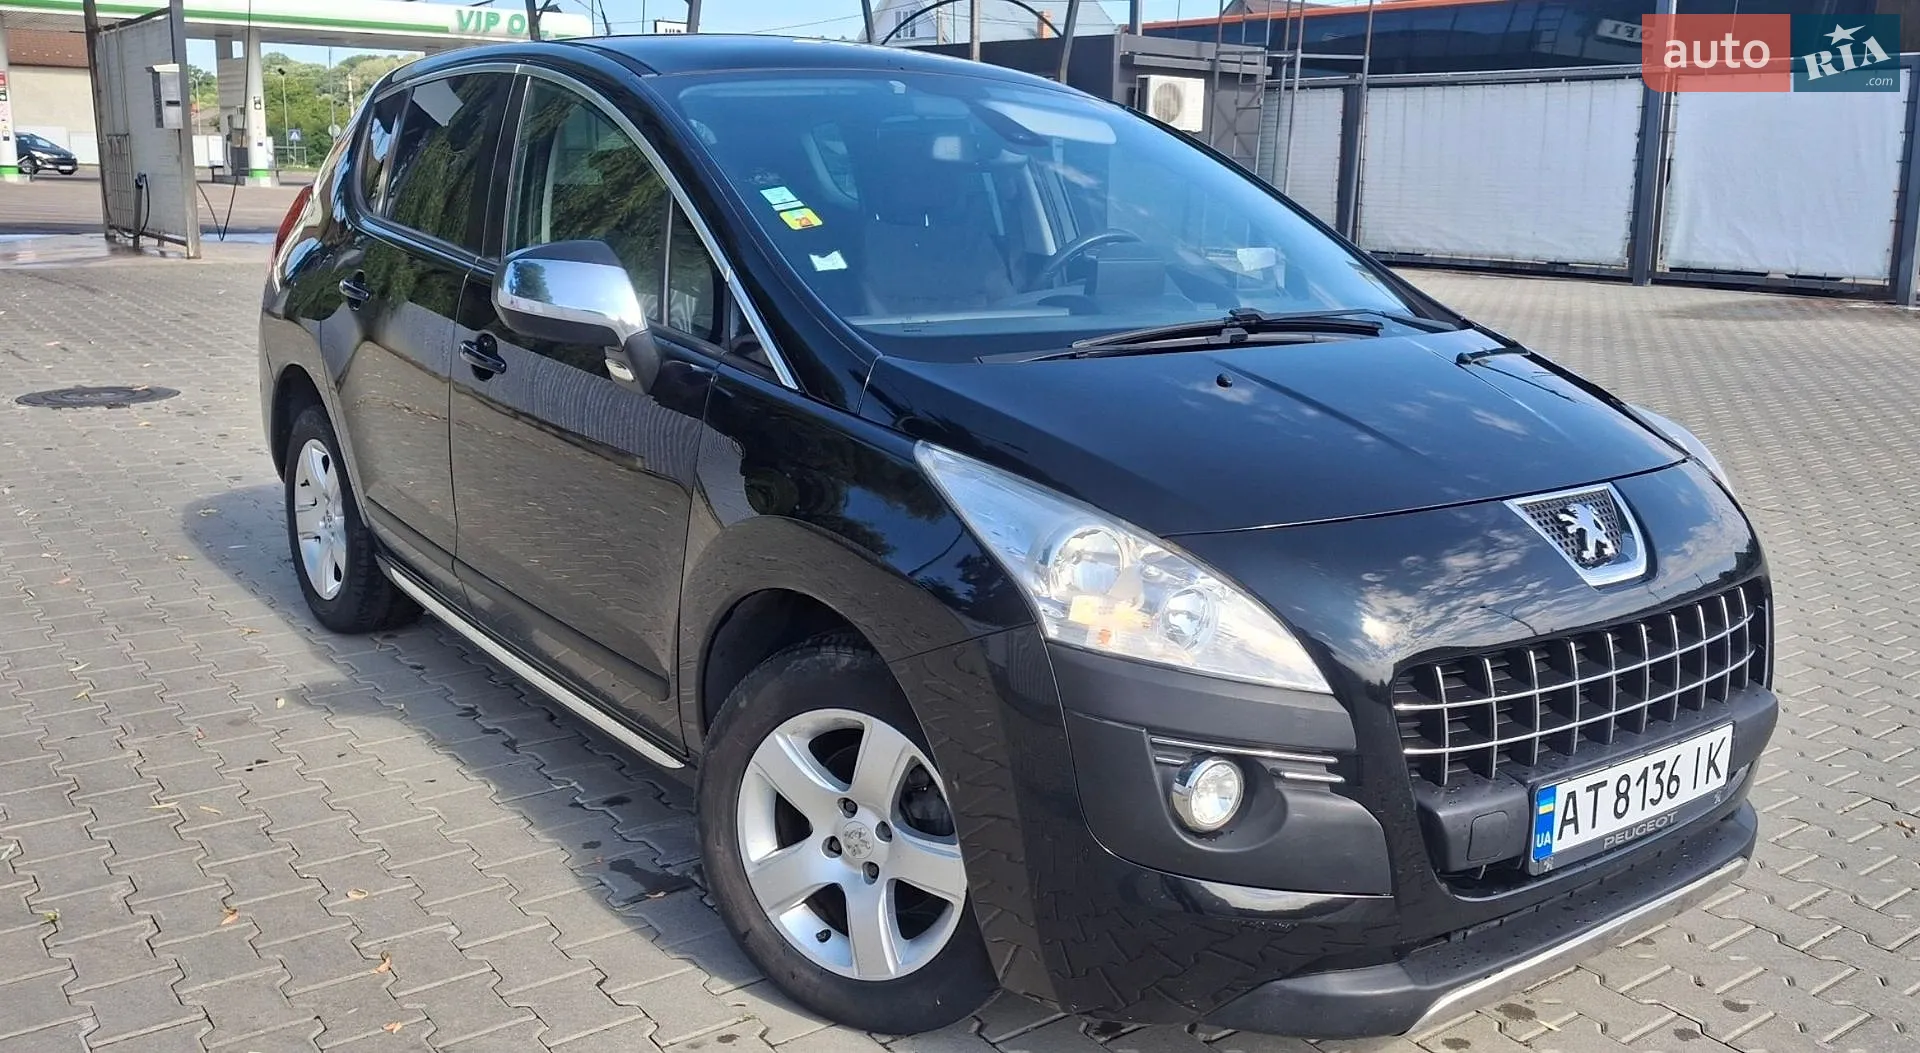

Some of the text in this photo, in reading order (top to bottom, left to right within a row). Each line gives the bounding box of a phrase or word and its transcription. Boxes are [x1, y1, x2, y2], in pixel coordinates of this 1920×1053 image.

[456, 10, 500, 33] VIP
[1692, 736, 1726, 790] IK
[1536, 831, 1552, 848] UA
[1603, 811, 1679, 850] PEUGEOT
